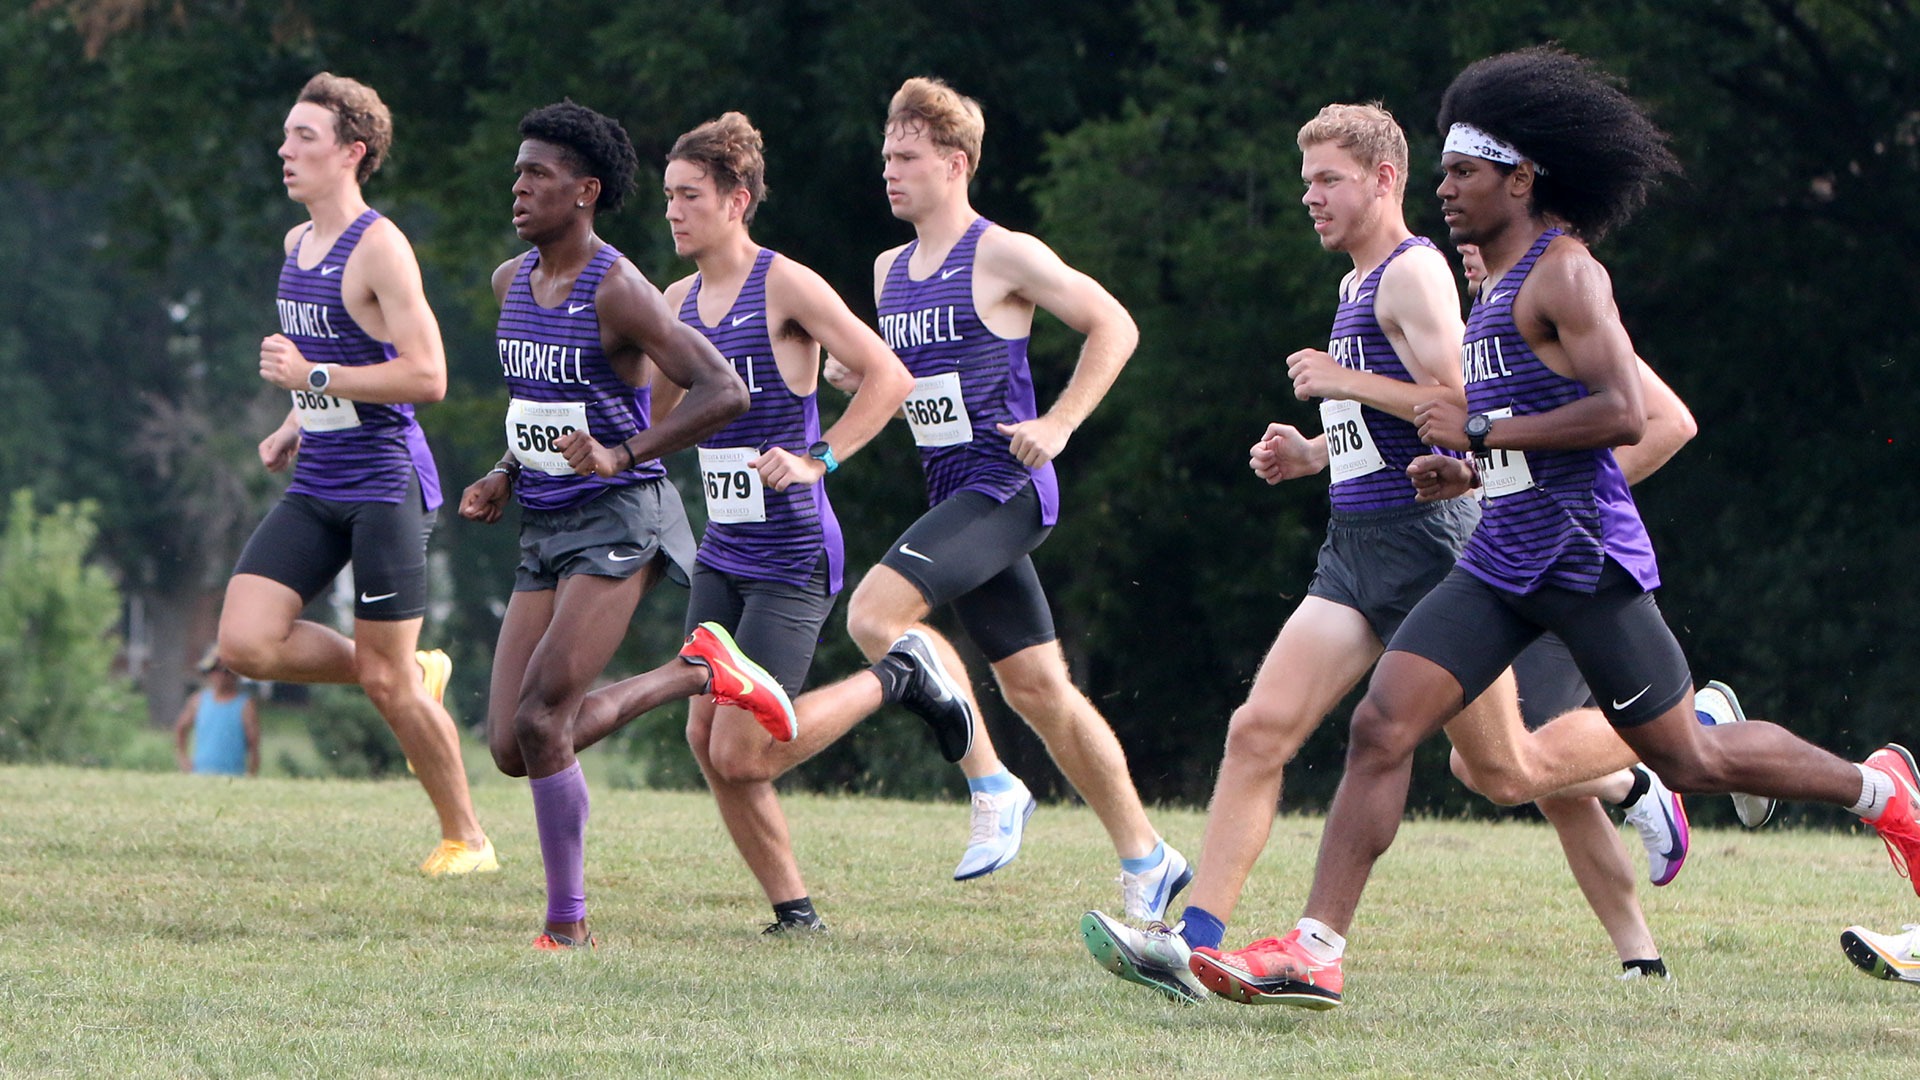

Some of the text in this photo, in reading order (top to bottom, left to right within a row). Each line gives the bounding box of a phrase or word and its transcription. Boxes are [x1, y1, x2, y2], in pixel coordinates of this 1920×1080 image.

[276, 298, 339, 339] ORNELL
[499, 338, 591, 386] CORNELL
[1328, 335, 1373, 374] RNELL
[1462, 336, 1513, 386] ORNELL
[905, 396, 958, 426] 5682
[1326, 419, 1363, 457] 5678
